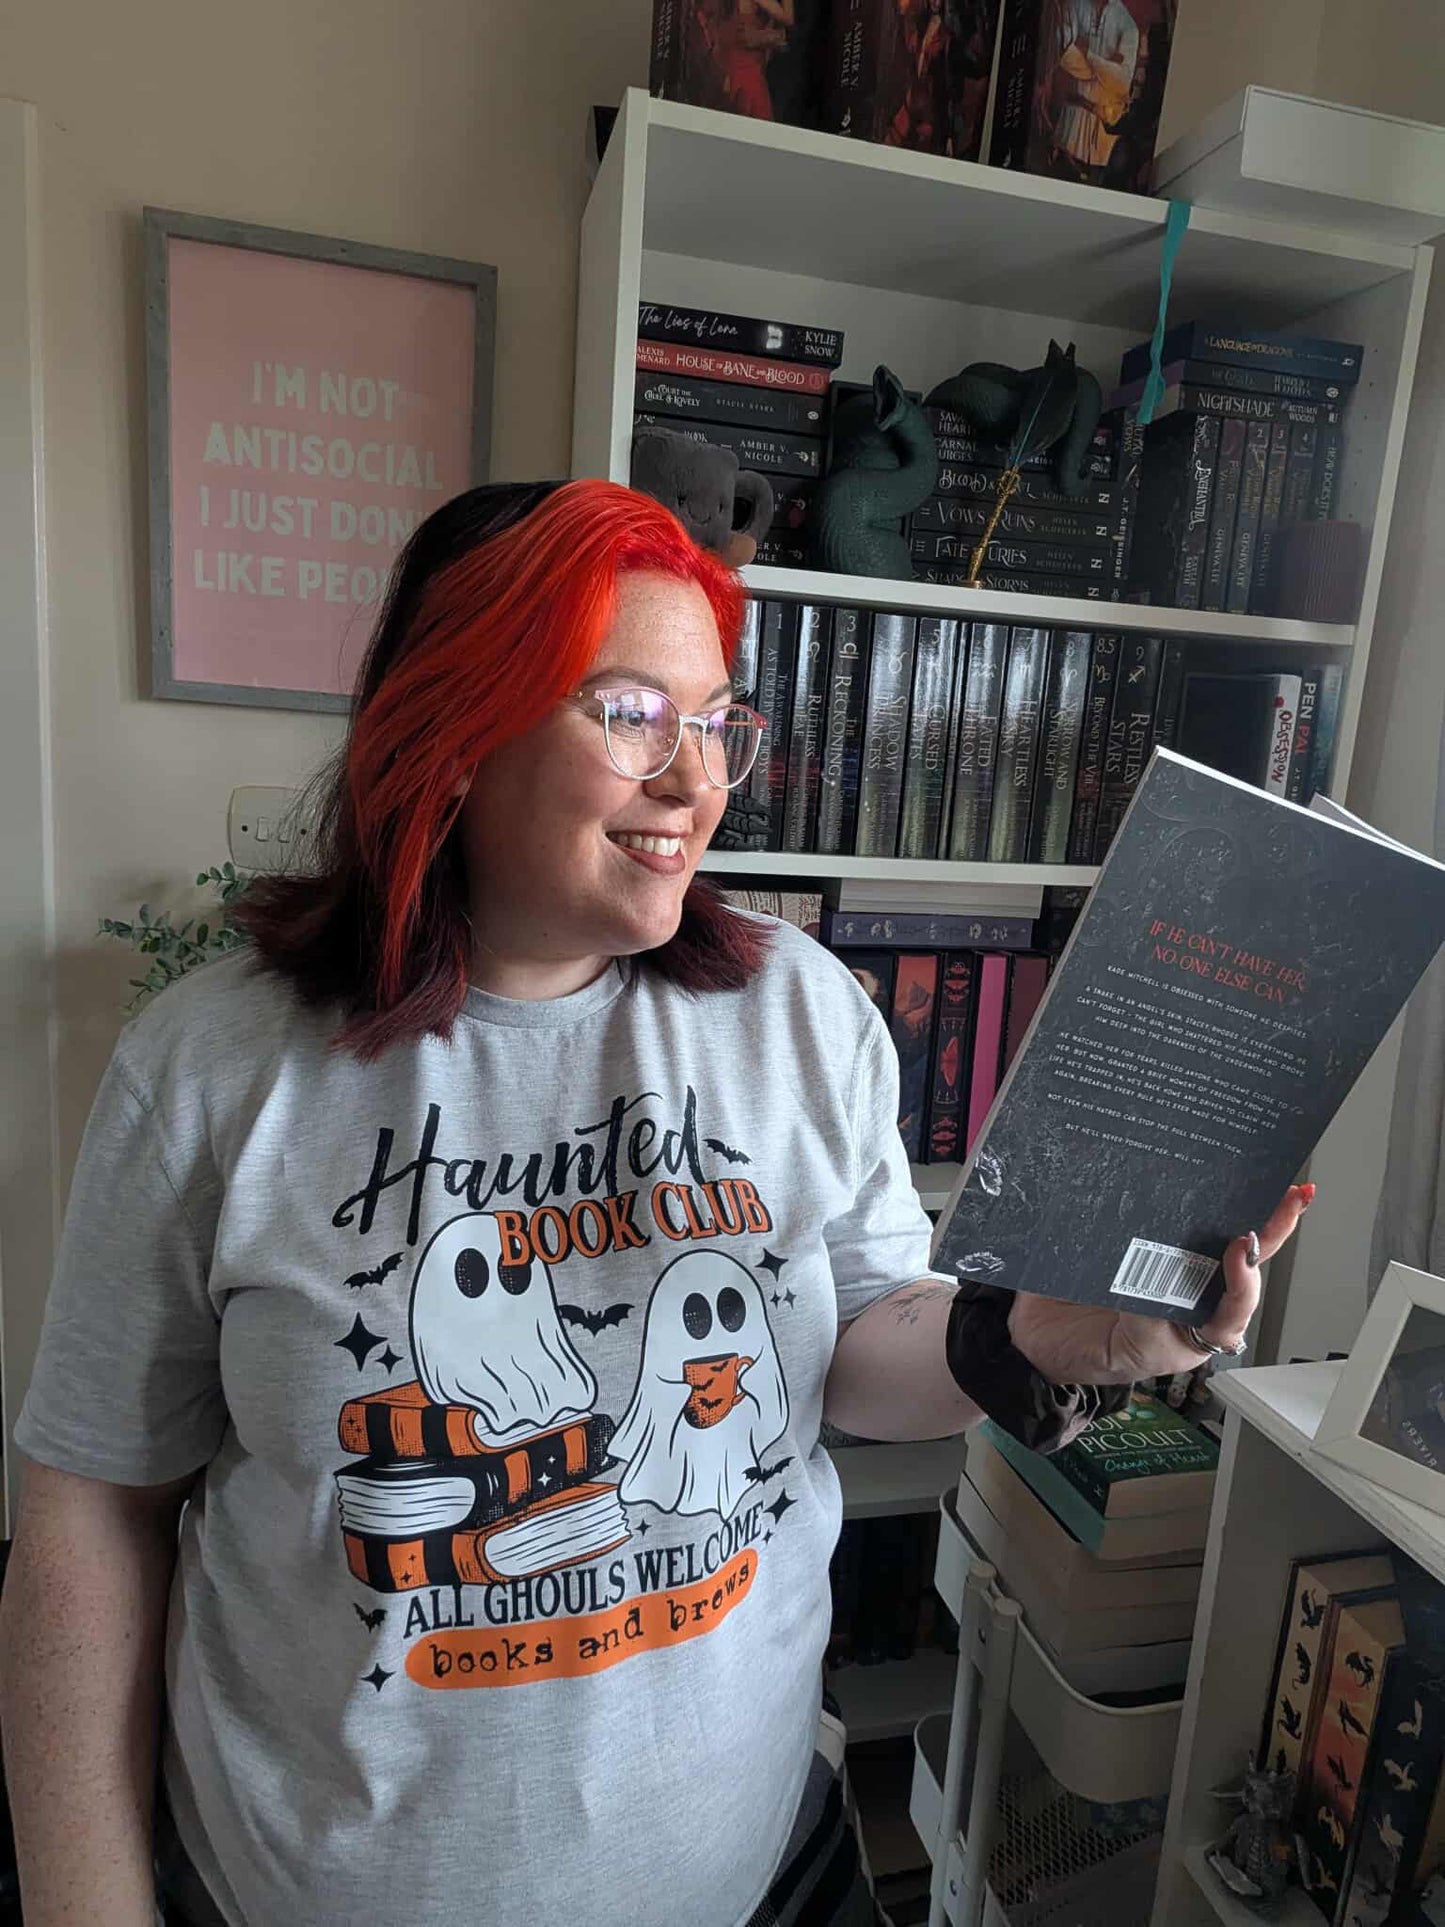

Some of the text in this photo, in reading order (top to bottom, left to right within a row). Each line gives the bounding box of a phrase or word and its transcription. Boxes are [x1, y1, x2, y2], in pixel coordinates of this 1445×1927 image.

[636, 305, 662, 328] The
[664, 310, 692, 331] Lies
[693, 314, 708, 338] of
[804, 330, 837, 346] KYLIE
[636, 346, 665, 357] ALEXIS
[636, 353, 670, 365] MENARD
[675, 353, 805, 388] HOUSE BANE BLOOD
[804, 344, 834, 358] SNOW
[252, 361, 402, 422] I'M NOT
[1196, 391, 1275, 418] NIGHTSHADE
[1287, 403, 1318, 415] AUTUMN
[1288, 412, 1315, 423] WOODS
[203, 421, 443, 490] ANTISOCIAL
[739, 439, 775, 452] AMBER
[744, 451, 784, 464] NICOLE
[937, 448, 973, 462] URGES
[200, 485, 210, 527] I
[223, 487, 319, 538] JUST
[935, 501, 987, 528] VOWS
[1119, 497, 1130, 515] J.T.
[1186, 459, 1212, 532] ENCHANTRA
[193, 547, 286, 597] LIKE
[934, 534, 971, 560] FATE
[984, 573, 1029, 593] STORMS
[776, 612, 782, 630] 1
[810, 611, 821, 628] 2
[840, 614, 856, 632] 3
[1065, 640, 1076, 657] 8
[1096, 637, 1116, 655] 8.5
[1134, 645, 1144, 661] 9
[756, 647, 778, 775] AS TOLD BY BOYS
[771, 692, 785, 746] AWAKENING
[802, 692, 822, 758] RUTHLESS
[825, 673, 852, 777] RECKONING
[865, 691, 889, 769] PRINCESS
[883, 694, 906, 771] SHADOW
[1294, 682, 1316, 754] PEN PAL
[922, 703, 945, 770] CURSED
[958, 706, 979, 776] THRONE
[976, 714, 997, 767] FATED
[1000, 725, 1018, 758] SKY
[1013, 699, 1037, 787] HEARTLESS
[1042, 709, 1063, 780] STARLIGHT
[1083, 696, 1104, 785] BEYOND THE VEIL
[1105, 720, 1125, 773] STARS
[1122, 712, 1149, 785] RESTLESS
[1268, 709, 1293, 784] OBSESSION
[1054, 761, 1069, 790] AND
[1149, 918, 1275, 976] IF HE CAN'T HAVE
[1127, 970, 1160, 987] MITCHELL
[1225, 1003, 1257, 1020] SOMEONE
[1150, 943, 1287, 1004] NO ONE ELSE CAN
[1098, 1001, 1126, 1017] FORGET
[1134, 1013, 1147, 1023] THE
[1167, 1023, 1184, 1035] WHO
[1237, 1047, 1261, 1060] HEART
[1262, 1056, 1278, 1066] AND
[1129, 1024, 1146, 1036] INTO
[1147, 1030, 1161, 1040] THE
[1209, 1050, 1223, 1060] THE
[1071, 1033, 1103, 1049] WATCHED
[1160, 1061, 1183, 1074] KILLED
[1184, 1068, 1211, 1082] ANYONE
[1251, 1090, 1275, 1104] CLOSE
[1277, 1100, 1288, 1109] TO
[1084, 1063, 1114, 1078] TRAPPED
[1143, 1081, 1160, 1091] BACK
[1225, 1106, 1236, 1115] TO
[1236, 1110, 1258, 1122] CLAIM
[1106, 1057, 1138, 1073] GRANTED
[1209, 1088, 1242, 1104] FREEDOM
[1243, 1100, 1264, 1112] FROM
[1266, 1108, 1280, 1119] THE
[1102, 1132, 1123, 1143] NEVER
[1138, 1117, 1154, 1127] STOP
[1156, 1122, 1169, 1131] THE
[1189, 1132, 1221, 1146] BETWEEN
[1191, 1108, 1210, 1119] MADE
[333, 1085, 706, 1245] Haunted
[494, 1179, 772, 1268] BOOK CLUB
[1077, 1429, 1196, 1453] PICOULT
[403, 1503, 764, 1639] ALL GHOULS WELCOME
[429, 1560, 751, 1678] books and brews
